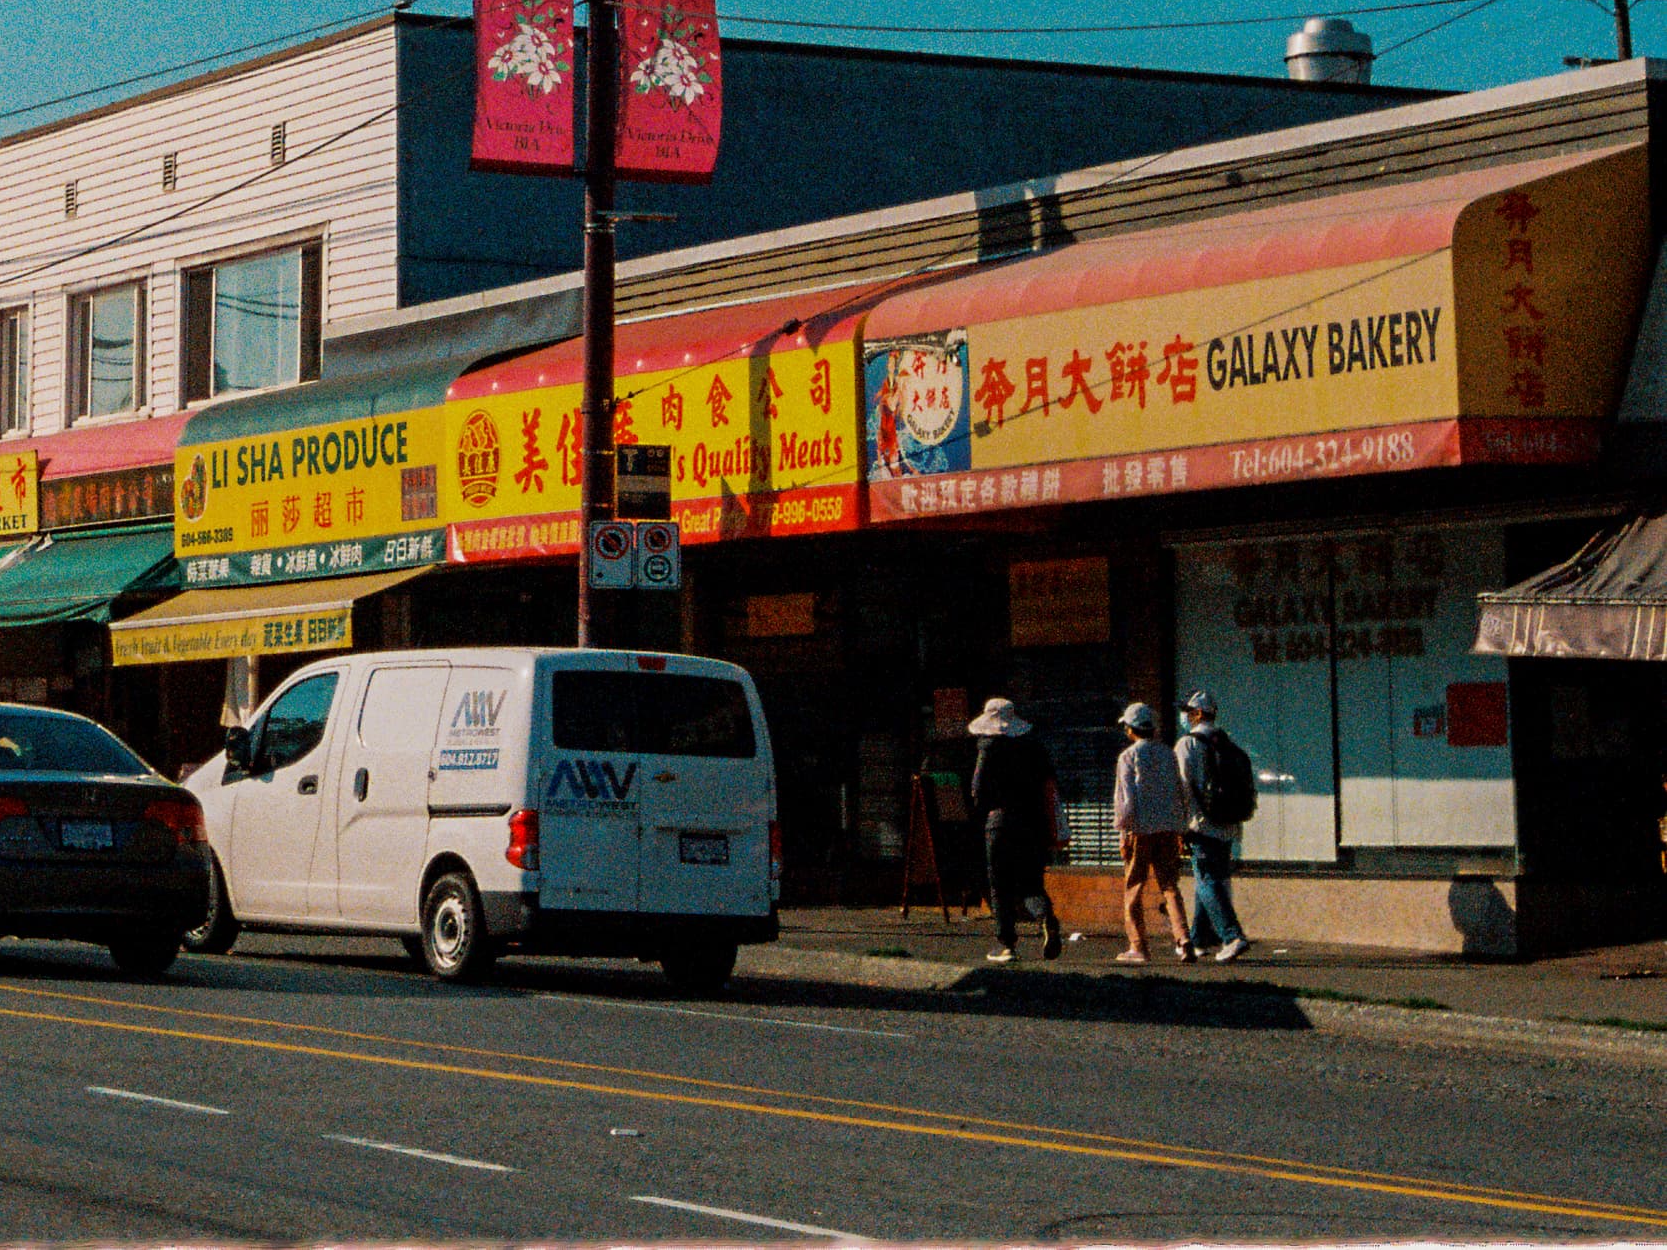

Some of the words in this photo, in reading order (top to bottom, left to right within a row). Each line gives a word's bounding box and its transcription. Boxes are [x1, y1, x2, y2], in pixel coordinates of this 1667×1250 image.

[974, 335, 1199, 428] 奔月大餅店
[1207, 324, 1318, 391] GALAXY
[1327, 307, 1442, 375] BAKERY
[212, 449, 228, 489] LI
[237, 441, 284, 486] SHA
[292, 421, 408, 478] PRODUCE
[693, 434, 772, 488] Quality
[778, 429, 843, 472] Meats
[250, 486, 366, 538] 丽莎超市
